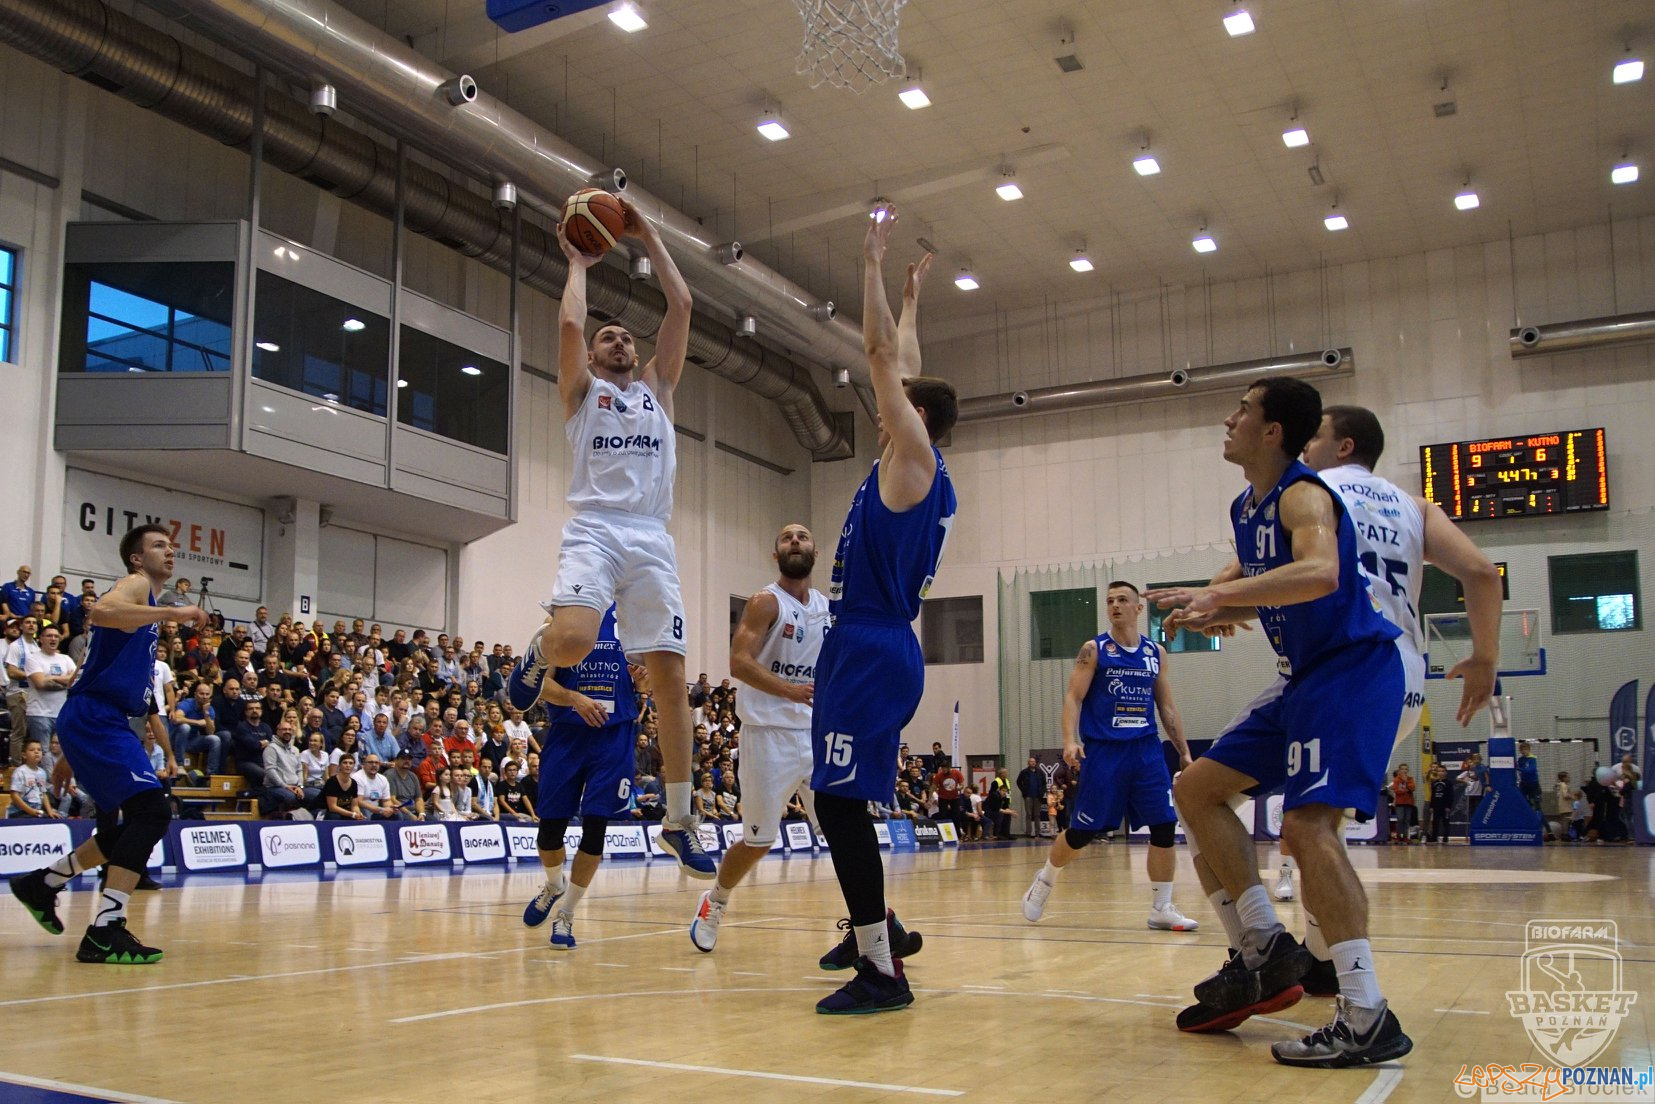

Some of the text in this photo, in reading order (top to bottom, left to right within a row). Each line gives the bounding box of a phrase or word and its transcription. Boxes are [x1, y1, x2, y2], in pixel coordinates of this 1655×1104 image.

[643, 393, 654, 412] 8
[593, 434, 660, 451] BIOFARM
[1469, 440, 1512, 452] BIOFARM
[1528, 436, 1560, 447] KUTNO
[1471, 455, 1482, 468] 9
[1536, 448, 1547, 462] 6
[1551, 469, 1559, 479] 3
[1466, 477, 1475, 487] 3
[1256, 524, 1276, 560] 91
[302, 598, 309, 611] B
[672, 614, 683, 640] 8
[579, 661, 620, 672] KUTNO
[1105, 667, 1151, 678] Polfarmex
[1142, 656, 1160, 675] 16
[1120, 686, 1152, 696] KUTNO
[824, 731, 854, 767] 15
[1287, 738, 1321, 777] 91
[617, 777, 631, 800] 6
[191, 830, 233, 844] HELMEX
[464, 838, 500, 848] BIOFARM
[0, 842, 64, 857] BIOFARM
[194, 845, 235, 854] EXHIBITIONS
[284, 841, 316, 851] posnania
